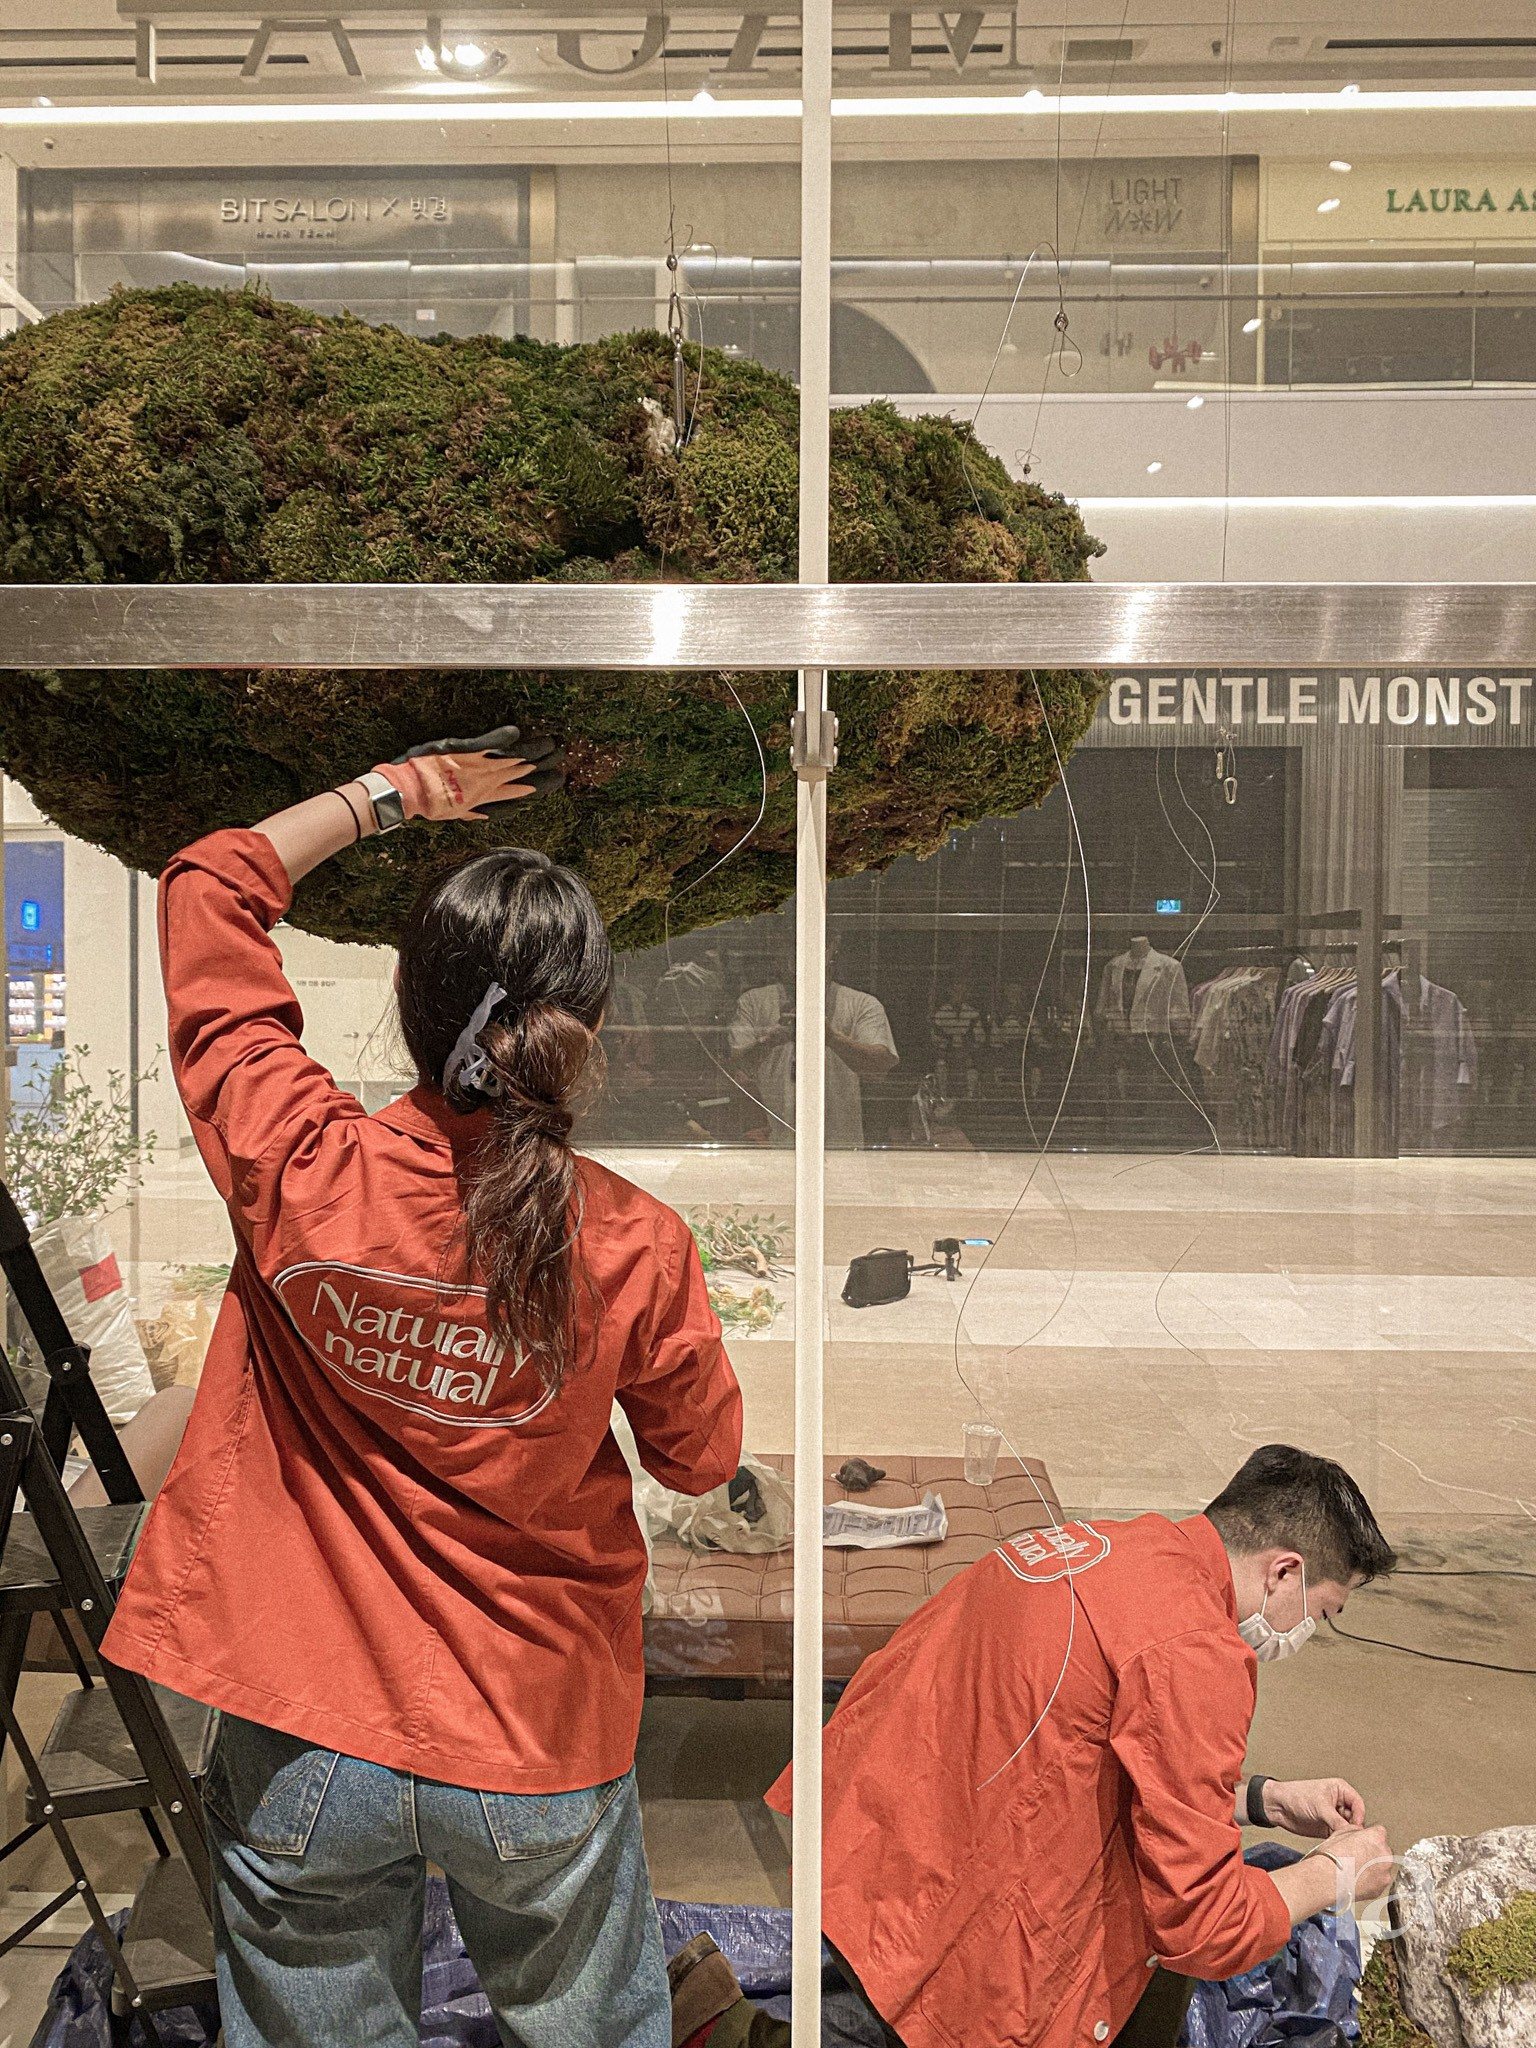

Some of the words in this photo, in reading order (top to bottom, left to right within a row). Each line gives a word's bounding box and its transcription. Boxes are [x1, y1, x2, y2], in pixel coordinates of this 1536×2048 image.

[1110, 177, 1181, 205] LIGHT
[1387, 187, 1497, 213] LAURA
[1109, 676, 1318, 726] GENTLE
[1338, 676, 1533, 726] MONST
[325, 1330, 499, 1406] natural
